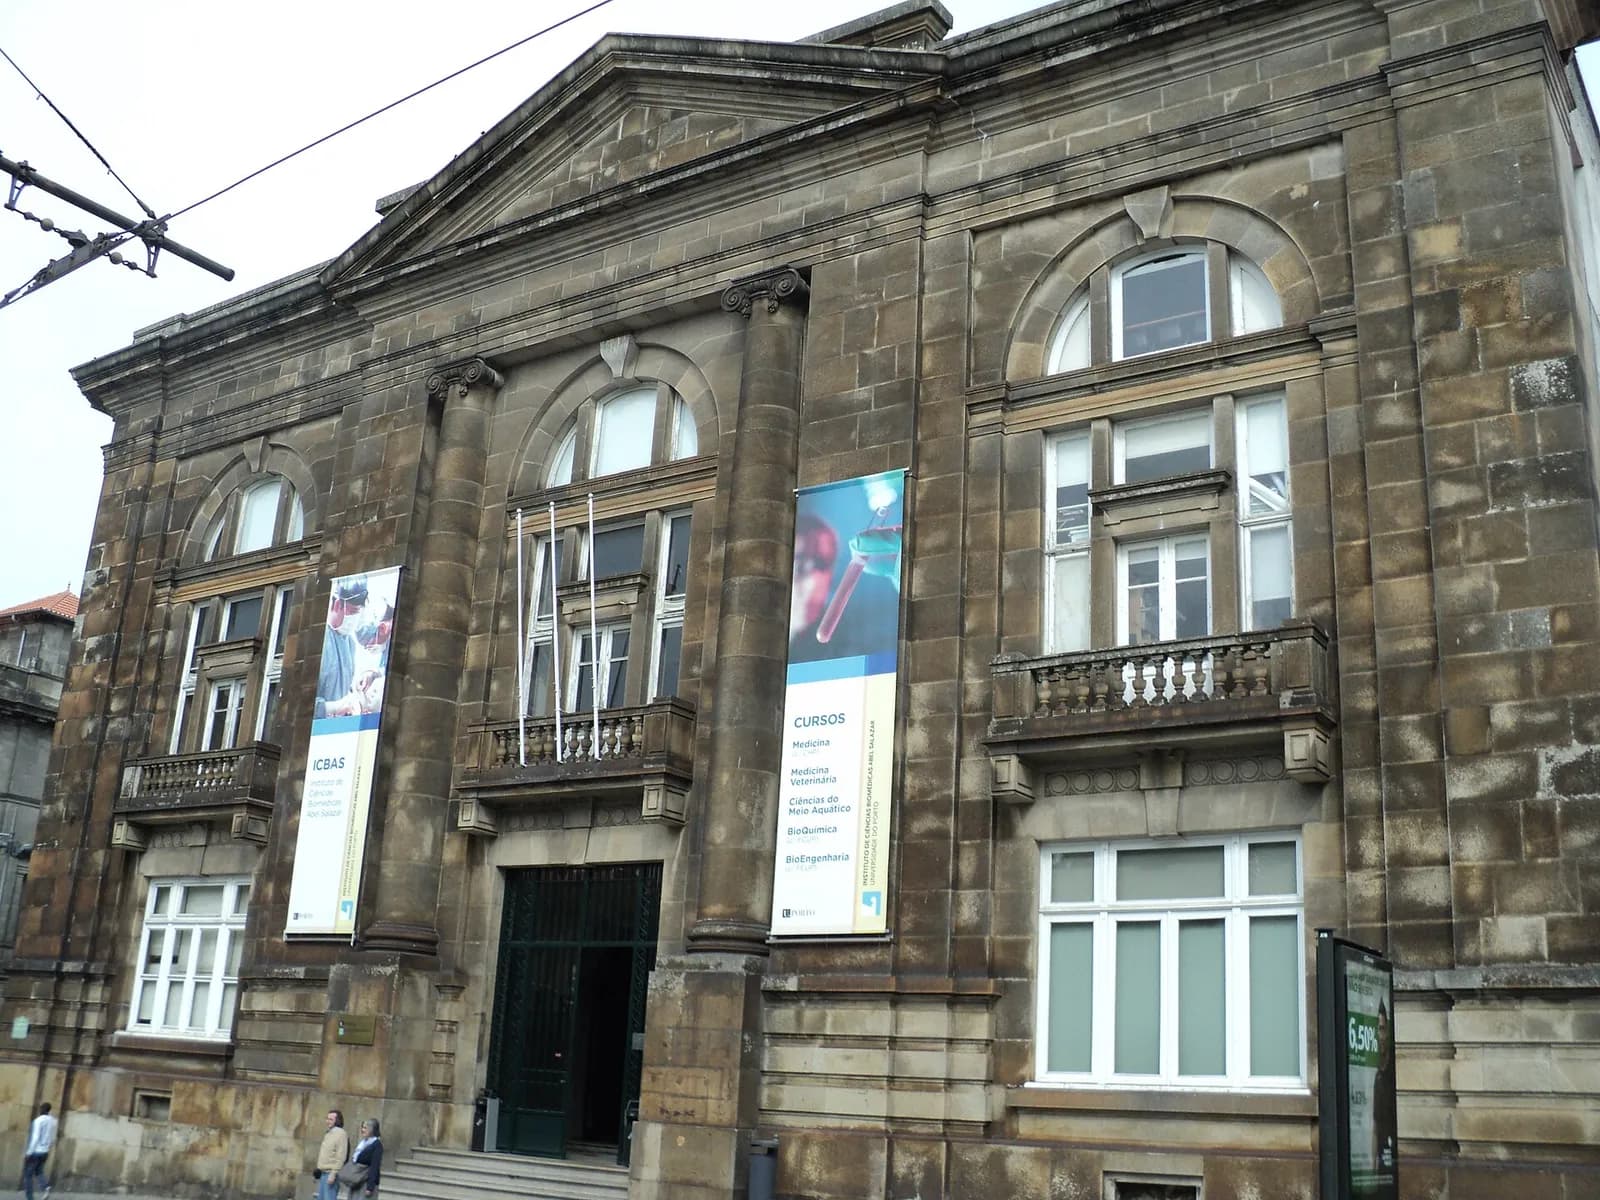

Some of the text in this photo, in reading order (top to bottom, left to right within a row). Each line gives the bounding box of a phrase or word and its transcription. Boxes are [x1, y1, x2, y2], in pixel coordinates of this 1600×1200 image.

[794, 713, 846, 728] CURSOS
[792, 739, 830, 749] Medicina
[313, 757, 345, 771] ICBAS
[791, 767, 829, 776] Medicina
[790, 776, 837, 786] Veterinária
[789, 795, 839, 806] Ciências do
[788, 804, 851, 816] Meio Aquático
[787, 825, 837, 836] BioQuímica
[786, 853, 849, 864] BioEngenharia
[1348, 1016, 1378, 1053] 6,50%
